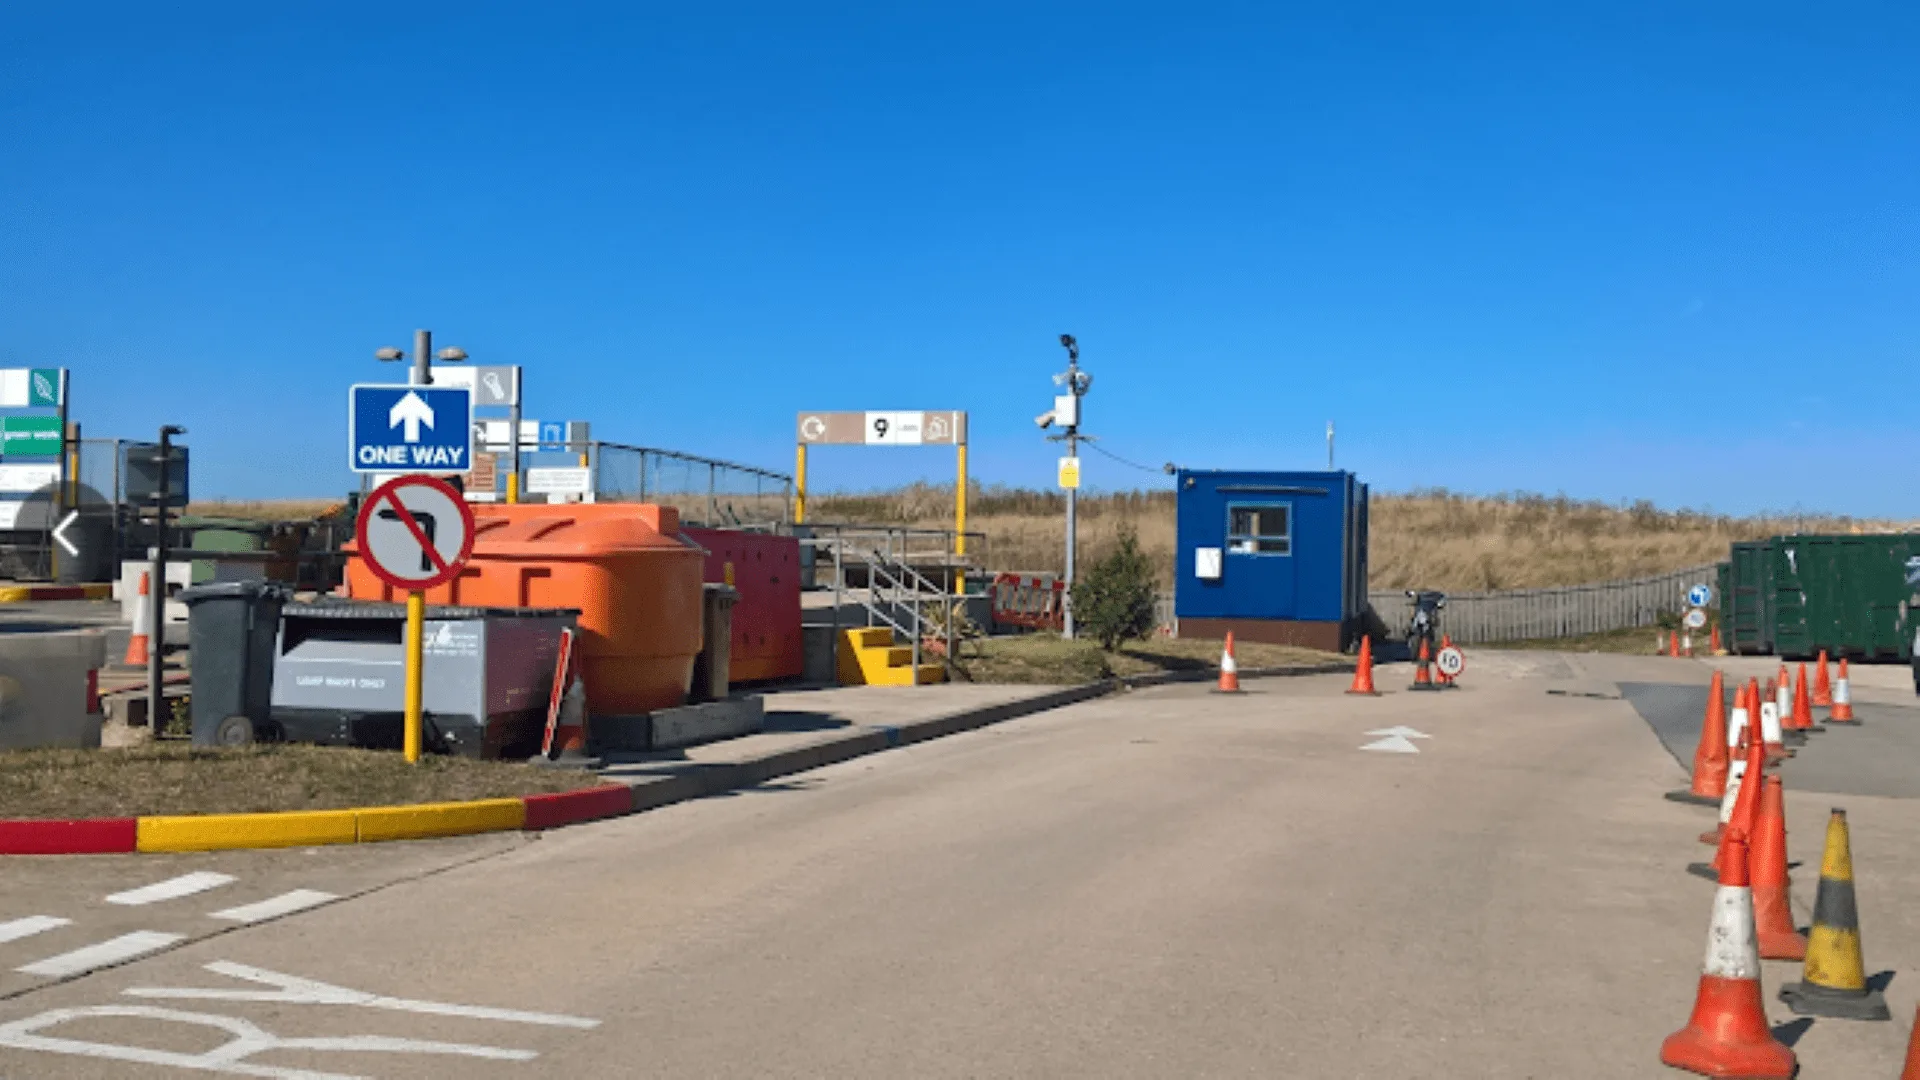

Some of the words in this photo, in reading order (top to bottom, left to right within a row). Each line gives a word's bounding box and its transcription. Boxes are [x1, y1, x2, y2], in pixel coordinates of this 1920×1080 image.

[874, 418, 889, 438] 9
[359, 445, 408, 464] ONE
[411, 445, 464, 465] WAY
